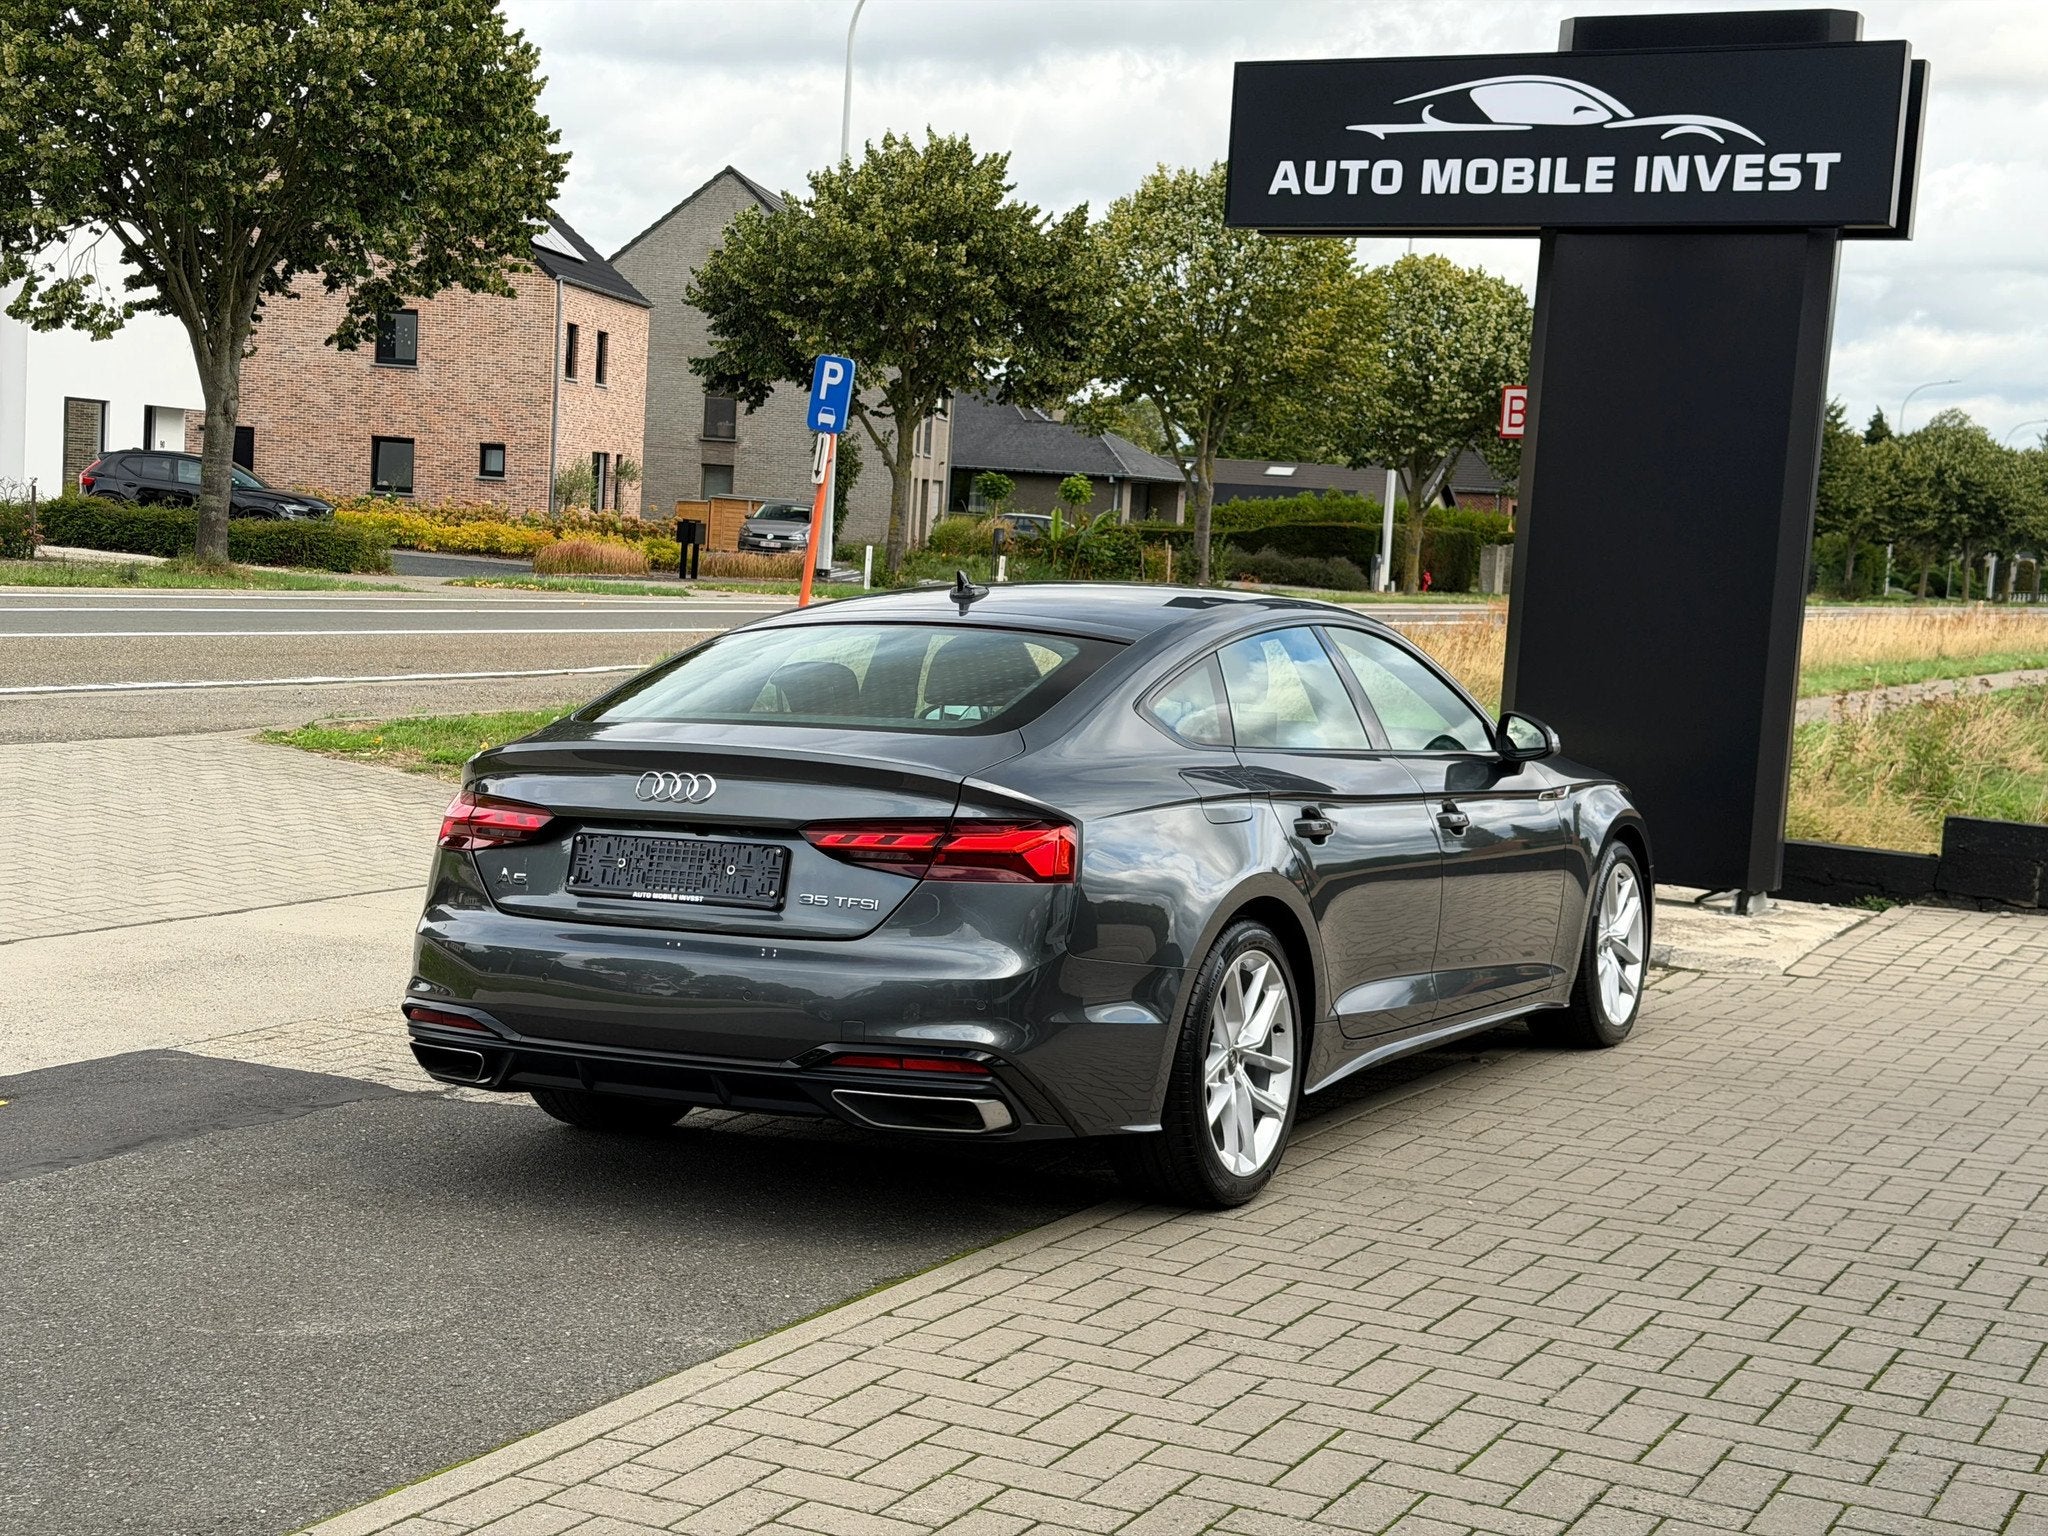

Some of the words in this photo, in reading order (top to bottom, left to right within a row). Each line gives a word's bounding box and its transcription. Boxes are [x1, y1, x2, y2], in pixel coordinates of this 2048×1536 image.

[1268, 159, 1403, 196] AUTO
[1420, 156, 1616, 196] MOBILE
[1633, 152, 1842, 193] INVEST
[819, 361, 844, 400] P
[496, 866, 528, 885] A5
[632, 891, 652, 899] AUTO
[653, 892, 679, 901] MOBILE
[679, 894, 705, 903] INVEST
[798, 893, 829, 907] 35
[834, 896, 880, 911] TFSI
